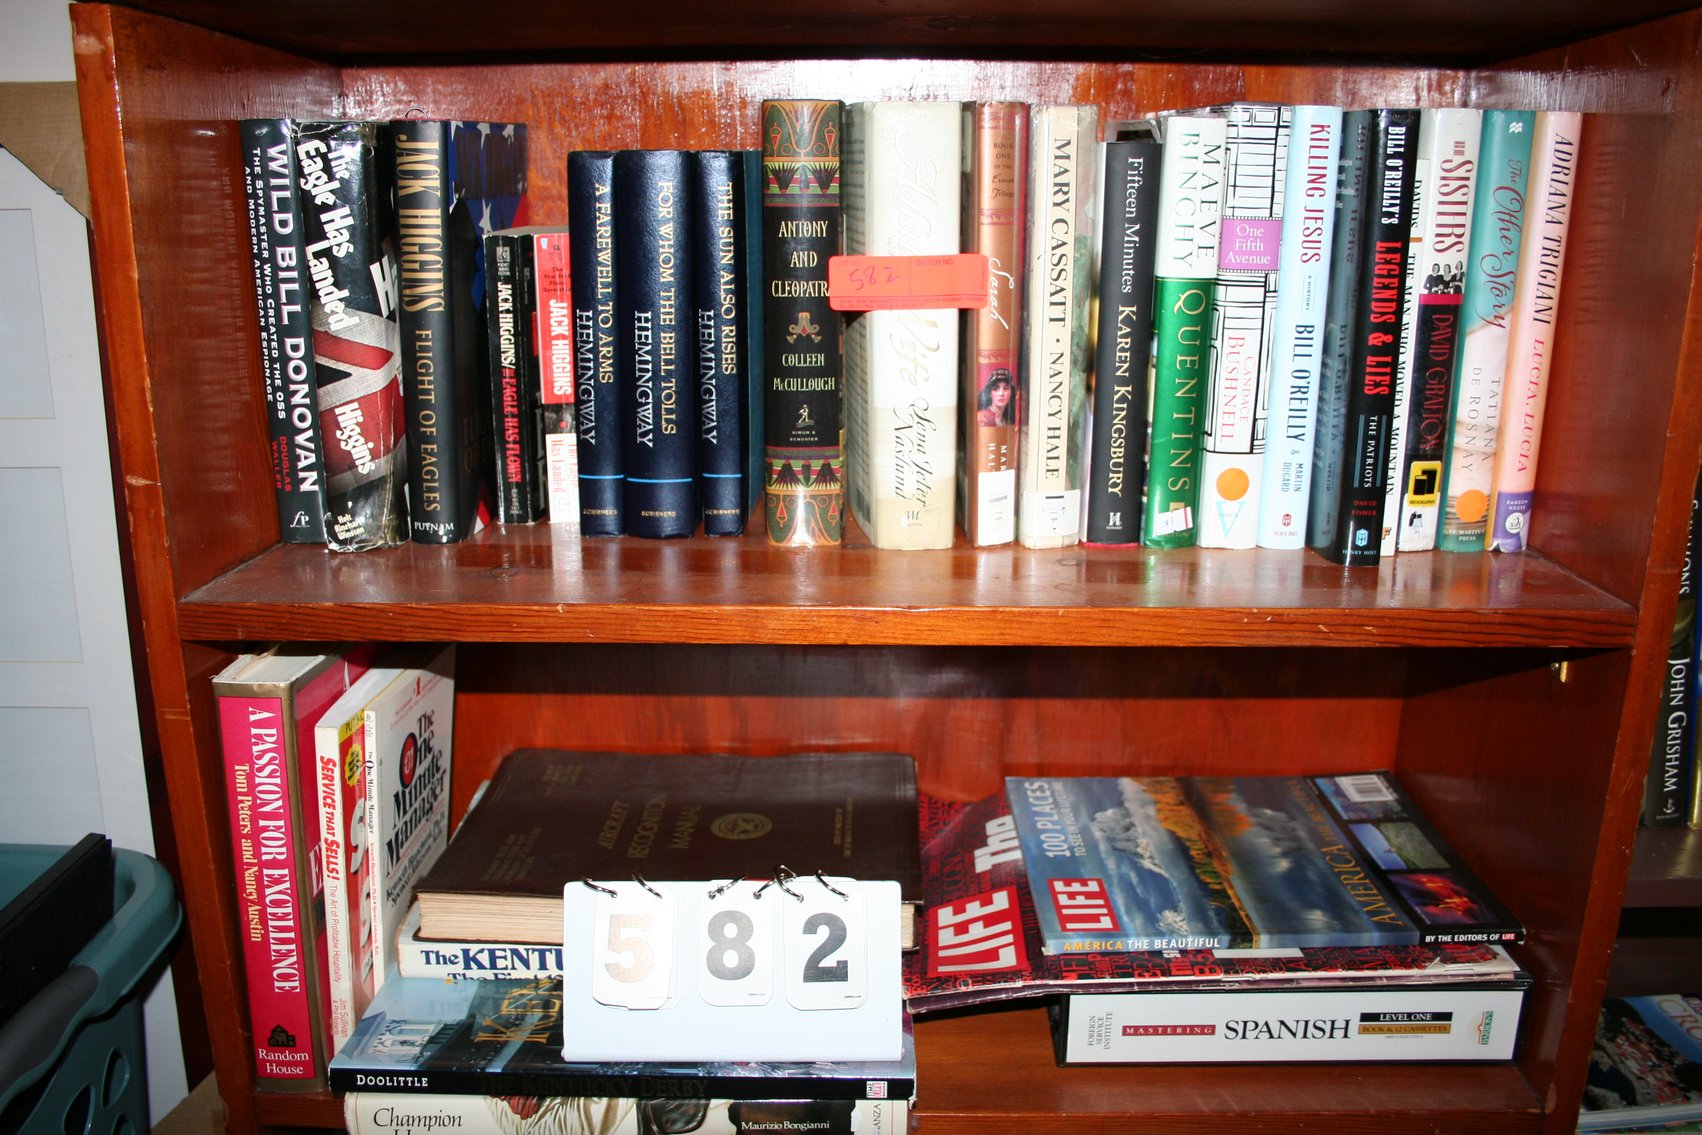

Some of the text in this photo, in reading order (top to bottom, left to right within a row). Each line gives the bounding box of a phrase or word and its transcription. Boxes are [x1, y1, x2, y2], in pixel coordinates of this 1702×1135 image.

[296, 140, 355, 259] Eagle Has
[1173, 133, 1200, 270] BINCHY
[1197, 143, 1222, 260] MAEVE
[1300, 123, 1331, 265] KILLING JESUS
[1432, 159, 1475, 254] SISTERS
[1507, 159, 1523, 183] The
[396, 132, 446, 313] JACK HIGGINS
[778, 220, 828, 238] ANTONY
[1225, 252, 1271, 265] Avenue
[1234, 238, 1264, 252] Fifth
[1236, 223, 1265, 237] One
[1492, 185, 1523, 260] Other
[1533, 133, 1575, 325] ADRIANA TRIGIANI
[244, 167, 274, 402] AND MODERN AMERICAN ESPIONAGE
[304, 241, 361, 331] Landed
[595, 184, 614, 384] A FAREWELL TO ARMS
[718, 182, 738, 375] THE SUN ALSO RISES
[790, 251, 818, 267] AND
[849, 264, 898, 291] 582
[989, 257, 1014, 332] Sarah
[1364, 126, 1406, 397] BILL O'REILLY'S LEGENDS & LIES
[1405, 253, 1416, 280] THE
[267, 143, 319, 493] WILD BILL DONOVAN
[549, 299, 568, 337] JACK
[656, 181, 677, 435] FOR WHOM THE BELL TOLLS
[1045, 138, 1072, 480] MARY CASSATT NANCY HALE
[1107, 157, 1144, 498] Fifteen Minutes KAREN KINGSBURY
[1403, 285, 1413, 317] MAN
[551, 339, 572, 396] HIGGINS
[782, 352, 825, 367] COLLEEN
[1292, 325, 1316, 363] BILL
[1397, 320, 1411, 355] WHO
[576, 308, 596, 446] HEMINGWAY
[634, 309, 653, 449] HEMINGWAY
[698, 308, 717, 446] HEMINGWAY
[773, 376, 836, 391] McCULLOUGH
[1167, 288, 1206, 492] QUENTINS
[1220, 336, 1246, 444] BUSHNELL
[1238, 357, 1255, 424] CANDACE
[1285, 368, 1312, 442] O'REILLY
[1393, 359, 1406, 409] MOVED
[1419, 314, 1454, 449] DAVID GRAFTON
[1517, 339, 1545, 473] LUCIA, LUCIA
[334, 402, 377, 476] Higgins
[415, 328, 441, 512] FLIGHT OF EAGLES
[1363, 415, 1378, 489] THE PATRIOTS
[1392, 413, 1400, 421] A
[1461, 367, 1482, 472] DE ROSNAY
[1481, 377, 1501, 462] TATIANA
[279, 436, 293, 494] DOUGLAS
[1280, 463, 1292, 493] DUGARD
[1293, 463, 1304, 493] MARTIN
[1385, 425, 1401, 496] MOUNTAIN
[414, 521, 454, 532] PUTNAM
[1351, 509, 1378, 517] FISHER
[416, 707, 435, 738] The
[1662, 656, 1691, 792] JOHN GRISHAM
[320, 756, 341, 881] SERVICE THAT SELLS!
[385, 771, 447, 878] Manager
[392, 749, 443, 829] Minute
[598, 800, 631, 850] AIRCRAFT
[1024, 781, 1071, 860] 100 PLACES
[234, 763, 263, 942] Tom Peters and Nancy Austin
[248, 706, 301, 993] A PASSION FOR EXCELLENCE
[669, 804, 703, 848] MANUAL
[974, 815, 1024, 874] The
[330, 898, 338, 911] Art
[937, 888, 1018, 975] LIFE
[1053, 880, 1113, 931] LIFE
[1454, 934, 1487, 942] EDITORS
[604, 913, 654, 984] 5
[705, 909, 756, 981] 8
[802, 912, 849, 983] 2
[1063, 938, 1220, 951] AMERICA THE BEAUTIFUL
[1103, 1011, 1113, 1050] INSTITUTE
[1223, 1019, 1351, 1041] SPANISH
[1380, 1013, 1432, 1021] LEVEL ONE
[258, 1048, 310, 1062] Random
[266, 1063, 304, 1075] House
[356, 1075, 428, 1087] DOOLITTLE
[640, 1076, 707, 1097] DERBY
[373, 1107, 463, 1128] Champion
[741, 1120, 830, 1132] Maurizio Bongianni
